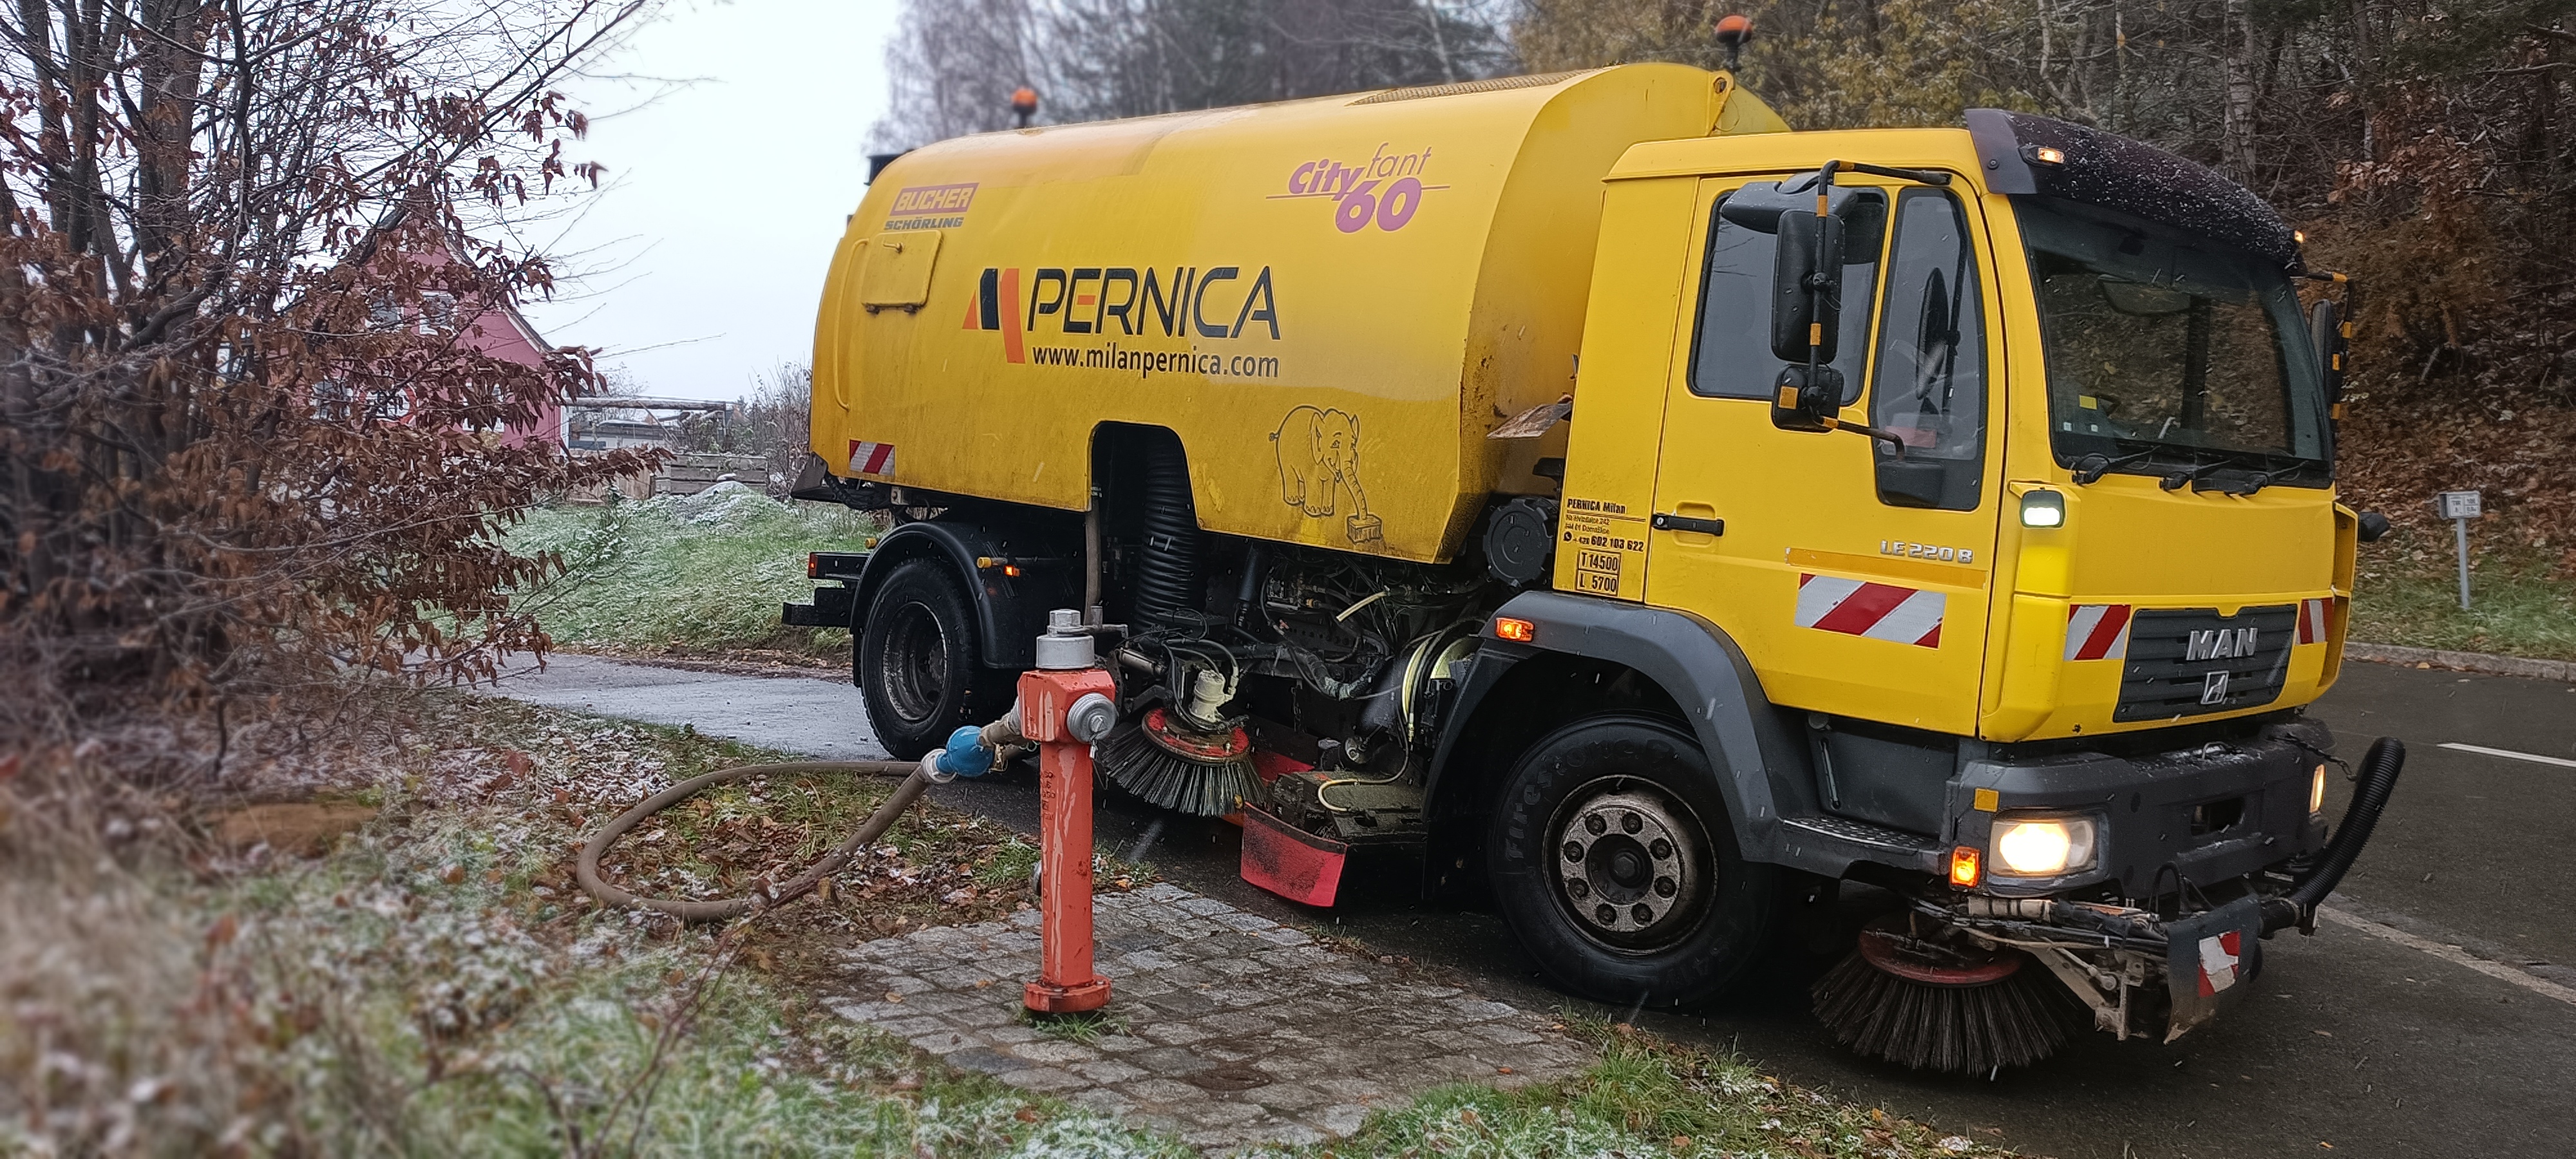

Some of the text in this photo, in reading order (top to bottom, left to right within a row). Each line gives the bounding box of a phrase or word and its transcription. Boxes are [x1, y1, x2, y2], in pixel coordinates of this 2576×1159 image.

[1289, 142, 1432, 201] City fant
[895, 187, 974, 211] BUCHER
[1336, 177, 1422, 233] 60
[884, 217, 964, 231] SCHÖRLING
[1028, 266, 1281, 340] PERNICA
[1032, 342, 1279, 379] www.milanpernica.com
[1603, 502, 1626, 514] Milan
[1591, 536, 1608, 547] 602
[1610, 538, 1625, 549] 103
[1627, 540, 1643, 551] 622
[1880, 540, 1973, 563] LE 220 B
[1582, 552, 1618, 571] T 14500
[1580, 573, 1617, 592] L 5700
[2186, 628, 2259, 661] MAN
